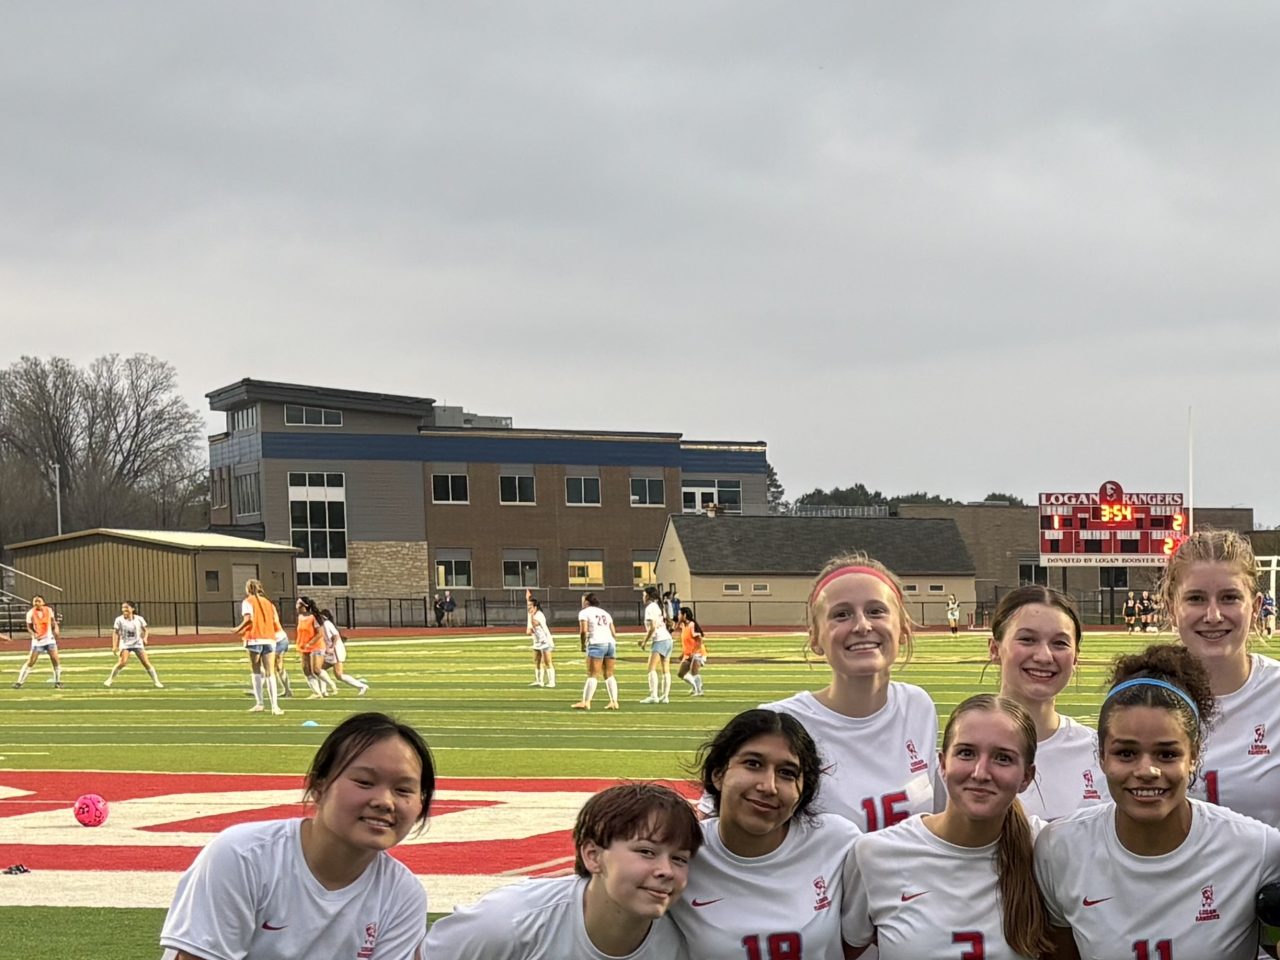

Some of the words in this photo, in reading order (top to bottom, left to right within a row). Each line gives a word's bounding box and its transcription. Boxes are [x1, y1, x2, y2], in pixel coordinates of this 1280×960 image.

[1041, 493, 1100, 505] LOGAN
[1122, 493, 1182, 505] RANGERS
[1101, 504, 1132, 522] 3:54
[1053, 515, 1060, 530] 1
[1172, 514, 1183, 531] 2
[1163, 537, 1174, 555] 2
